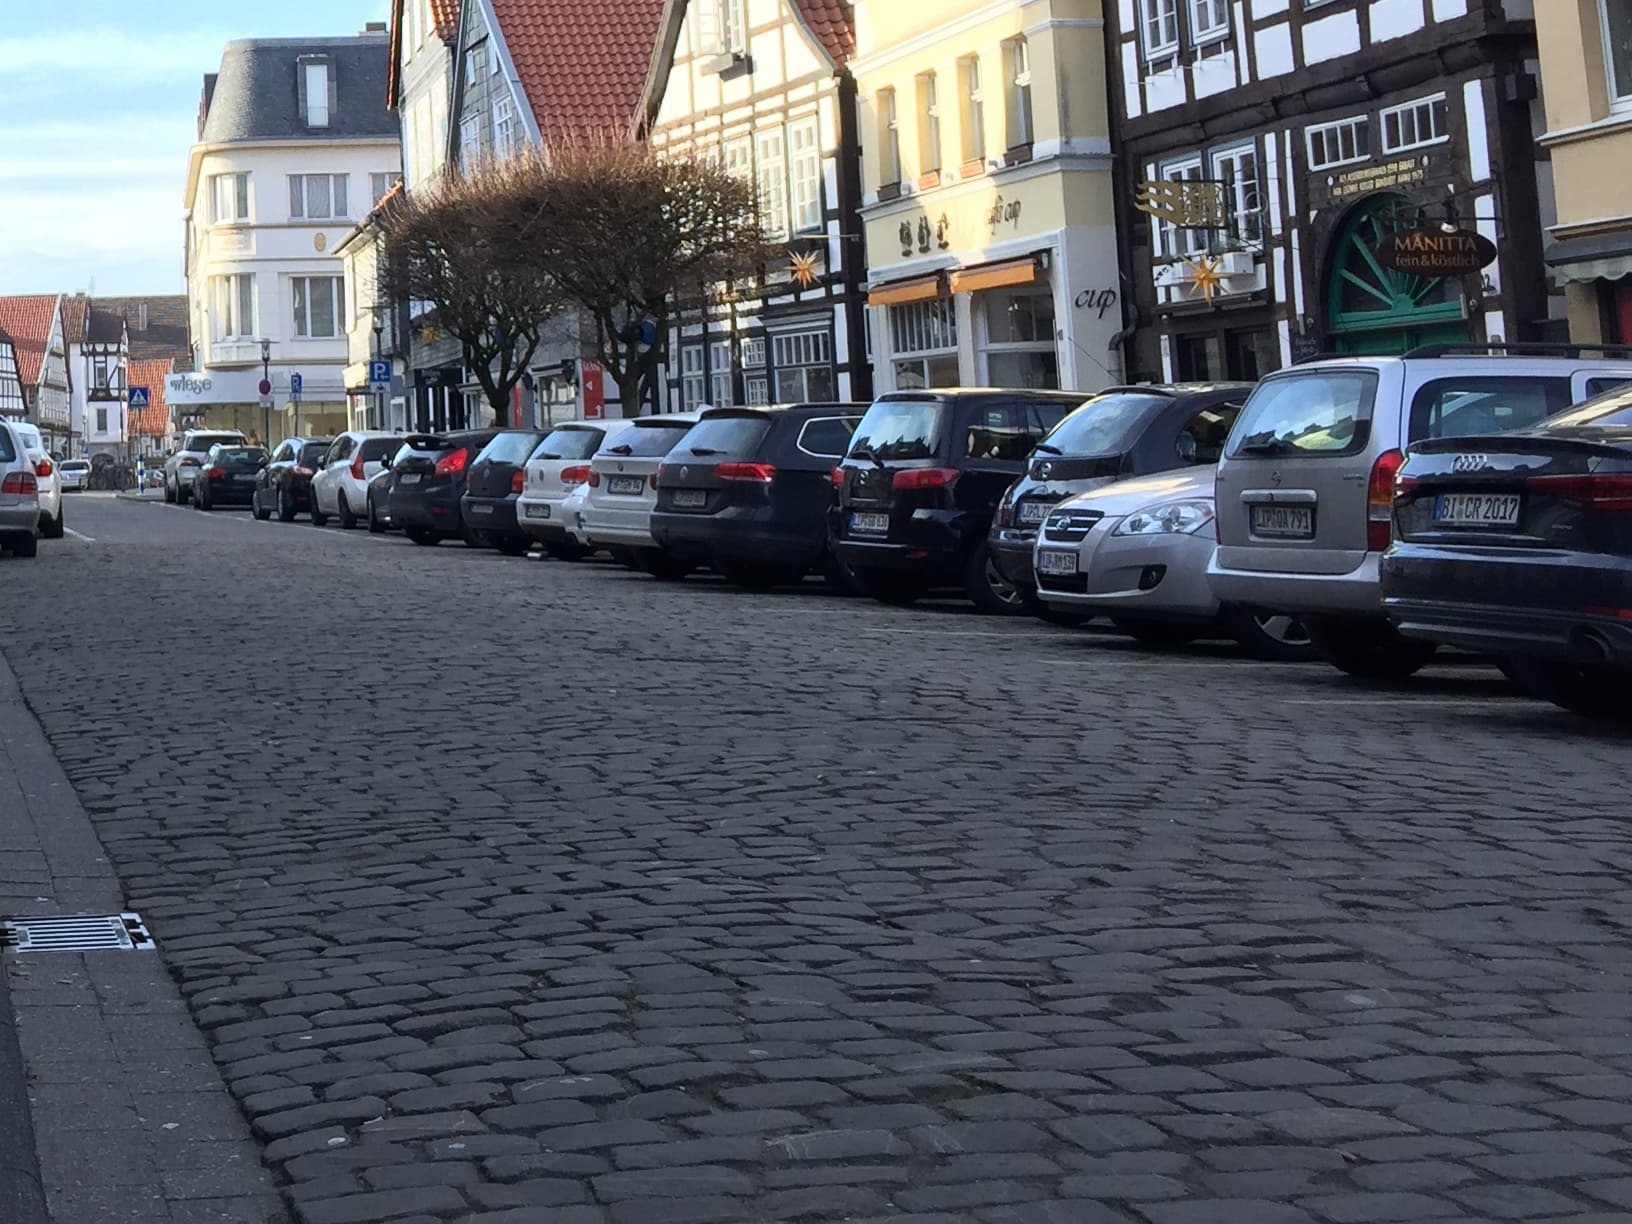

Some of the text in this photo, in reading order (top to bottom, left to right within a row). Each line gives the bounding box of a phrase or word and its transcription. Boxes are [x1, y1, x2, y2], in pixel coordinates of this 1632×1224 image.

[1074, 286, 1117, 320] cup
[374, 362, 386, 380] P
[1442, 496, 1518, 521] BI CR 2017
[1290, 510, 1309, 530] 791
